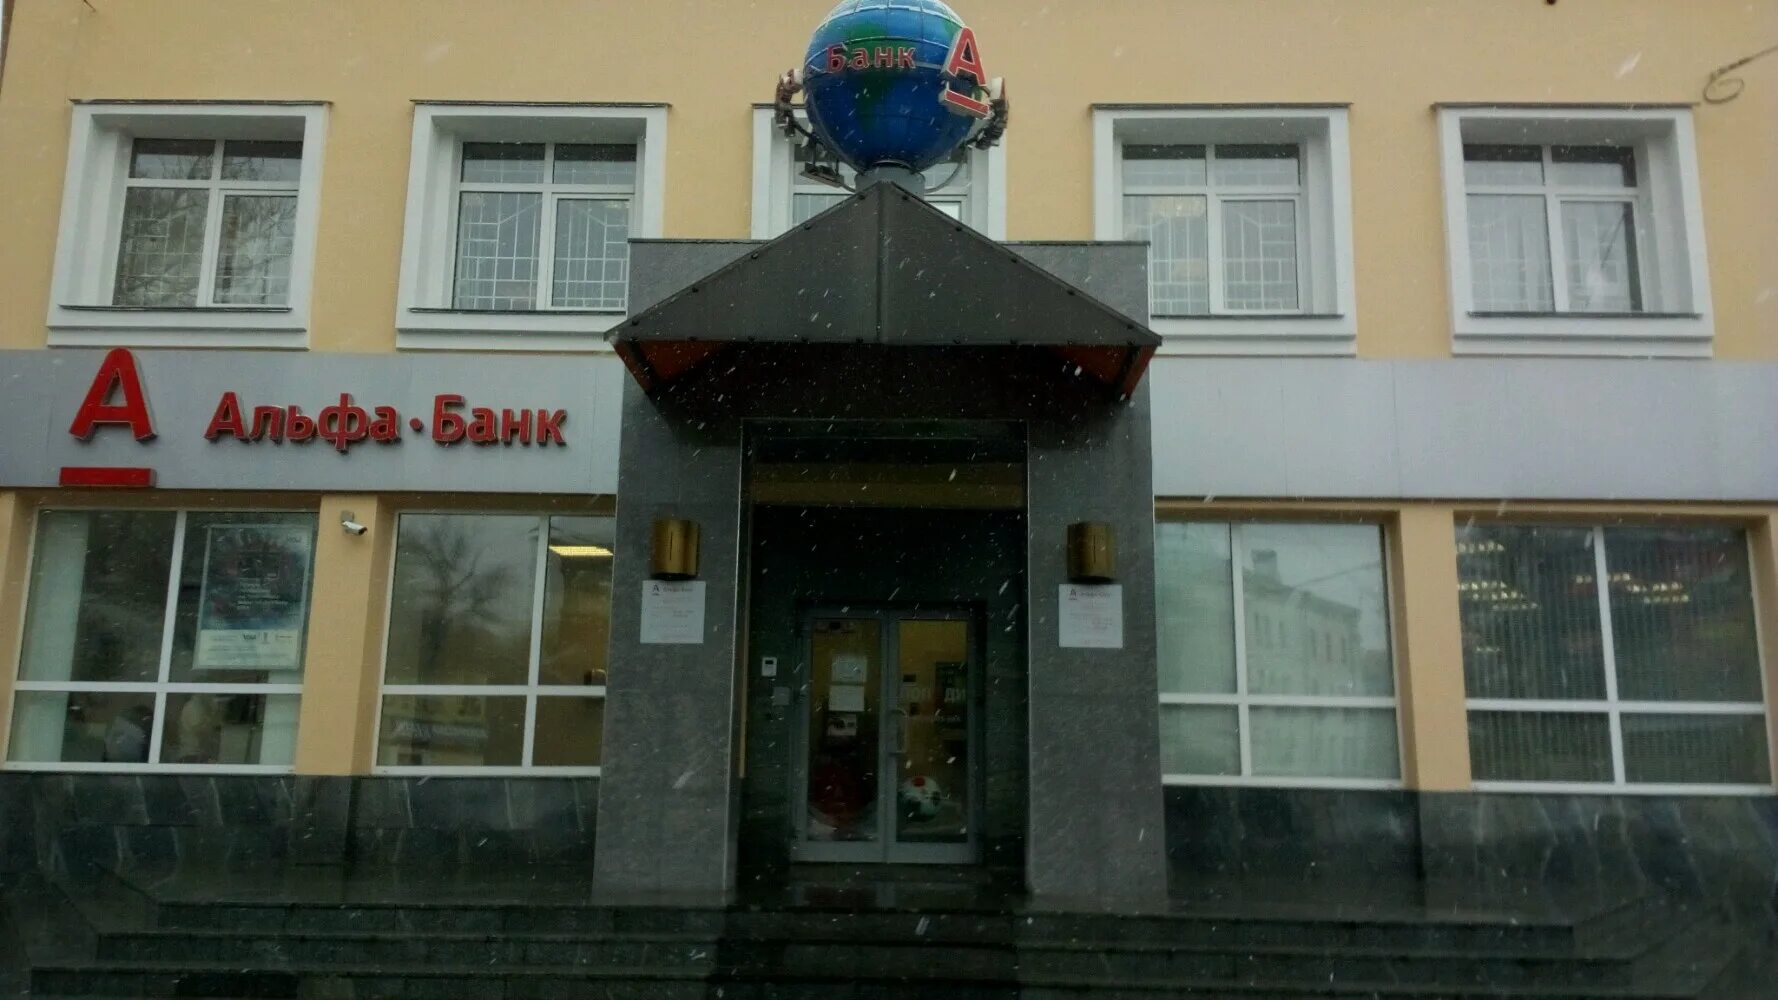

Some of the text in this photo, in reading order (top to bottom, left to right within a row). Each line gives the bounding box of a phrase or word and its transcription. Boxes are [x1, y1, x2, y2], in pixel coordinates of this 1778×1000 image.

[826, 43, 917, 73] Банк
[943, 27, 987, 87] А
[69, 346, 157, 442] А
[204, 391, 567, 454] Альфа Банк
